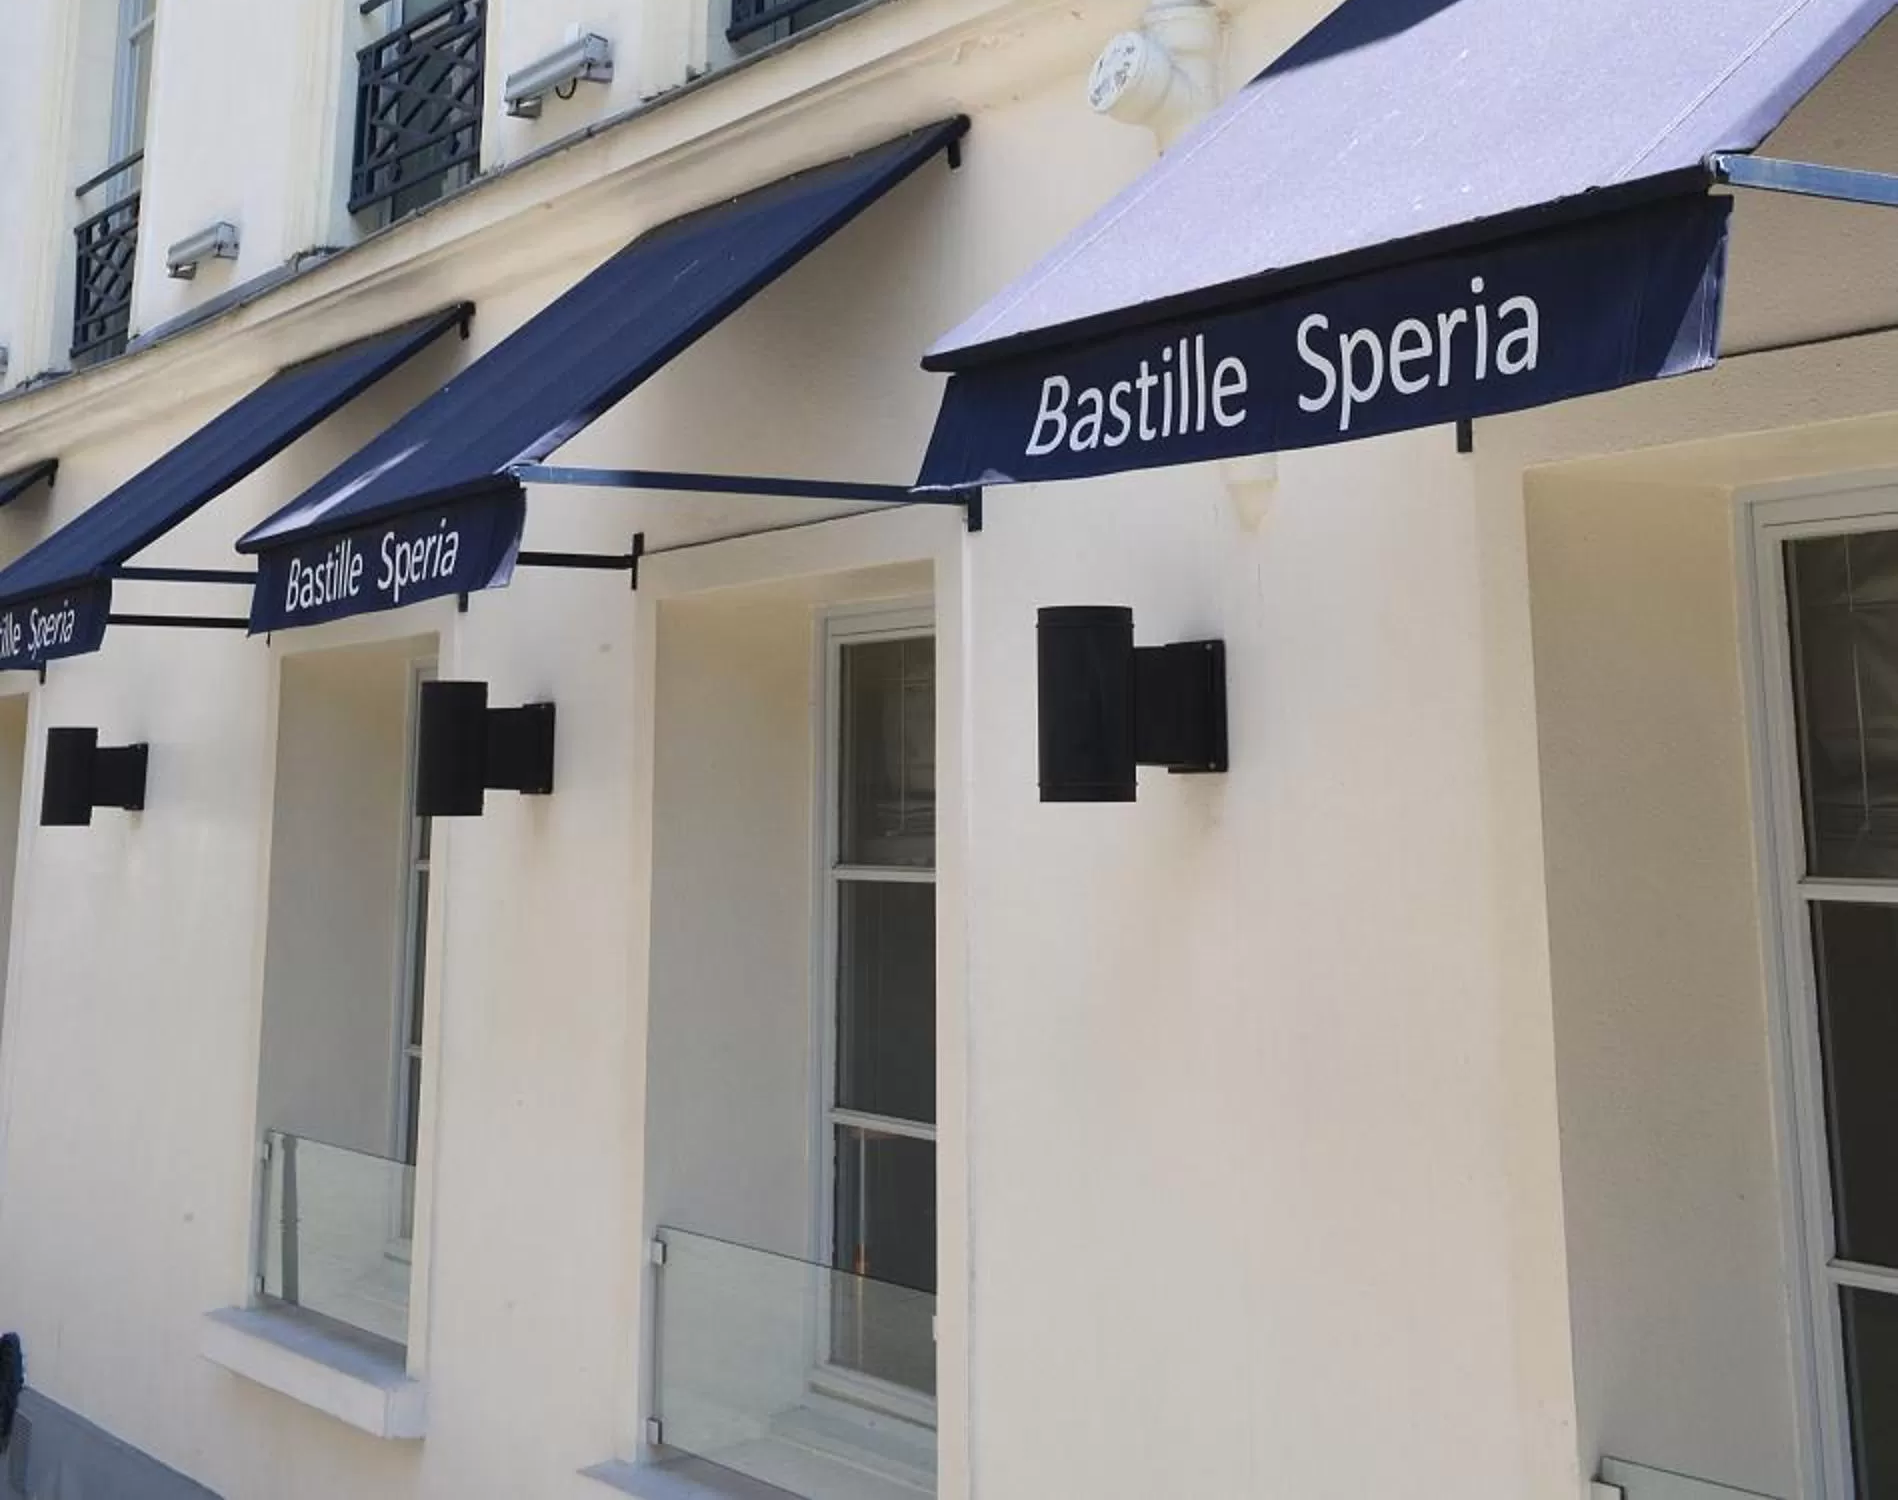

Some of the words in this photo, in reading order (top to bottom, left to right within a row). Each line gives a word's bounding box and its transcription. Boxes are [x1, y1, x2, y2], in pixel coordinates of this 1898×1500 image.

[1026, 334, 1248, 456] Bastille
[1297, 276, 1539, 431] Speria
[285, 538, 363, 613] Bastille
[377, 517, 459, 603] Speria
[28, 599, 75, 661] Speria
